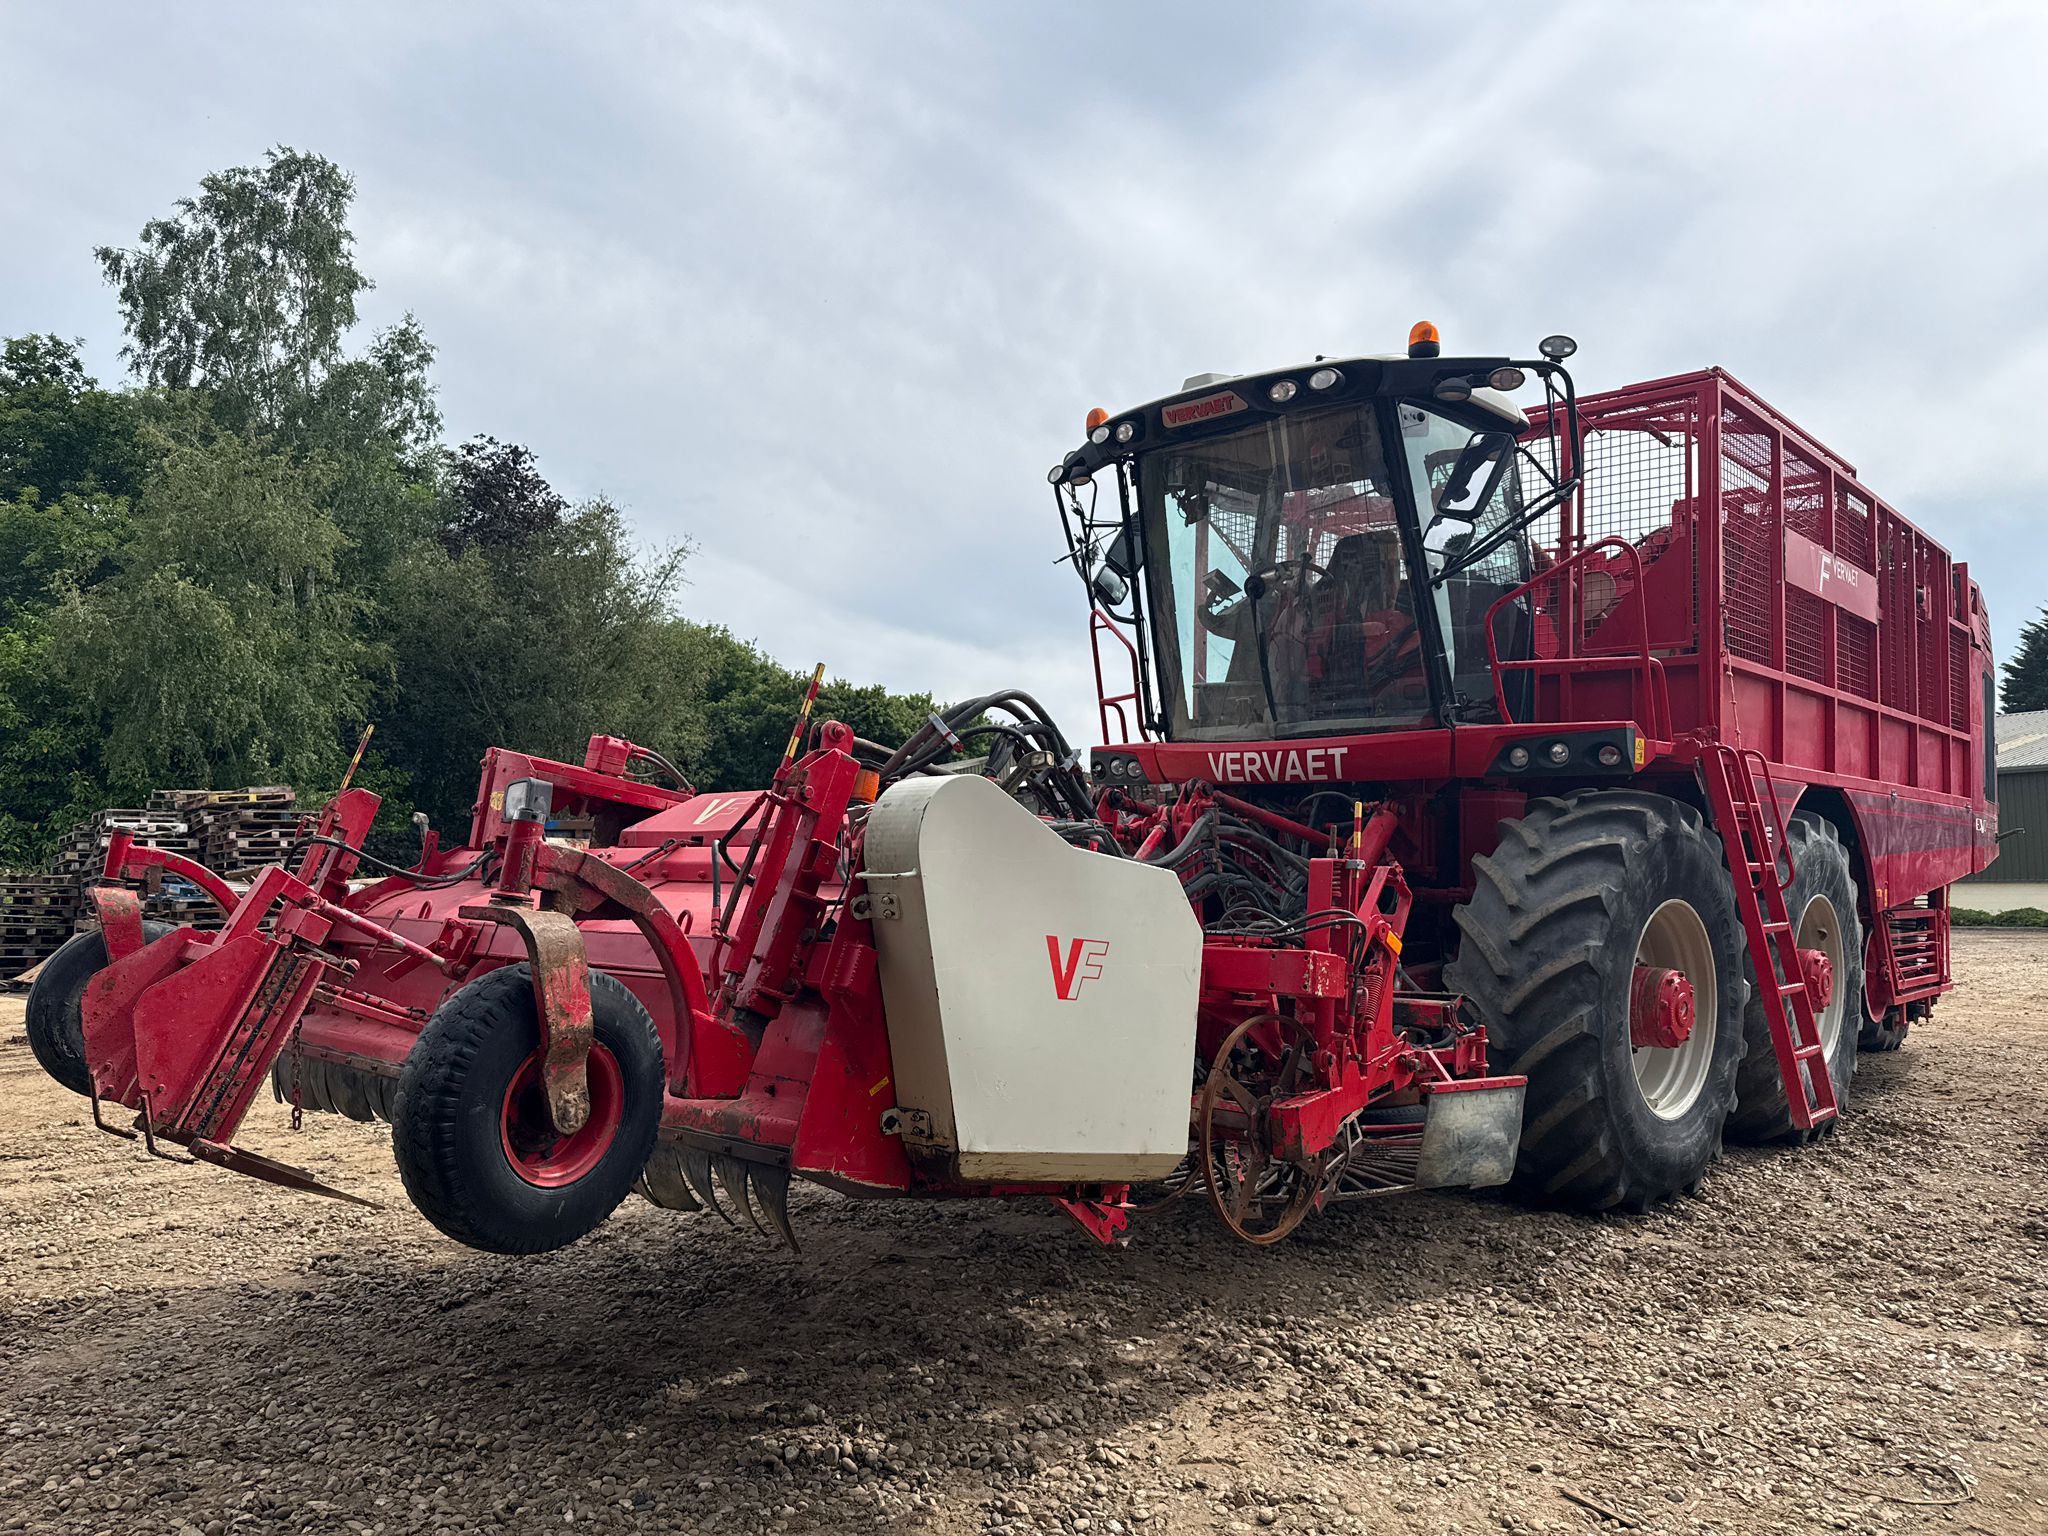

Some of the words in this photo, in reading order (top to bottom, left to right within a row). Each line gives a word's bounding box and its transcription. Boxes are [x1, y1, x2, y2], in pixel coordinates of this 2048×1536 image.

[1166, 395, 1234, 424] VERVAET
[1833, 559, 1859, 588] VERVAET
[1207, 747, 1348, 782] VERVAET
[693, 797, 755, 825] VF
[1046, 935, 1109, 1001] VF
